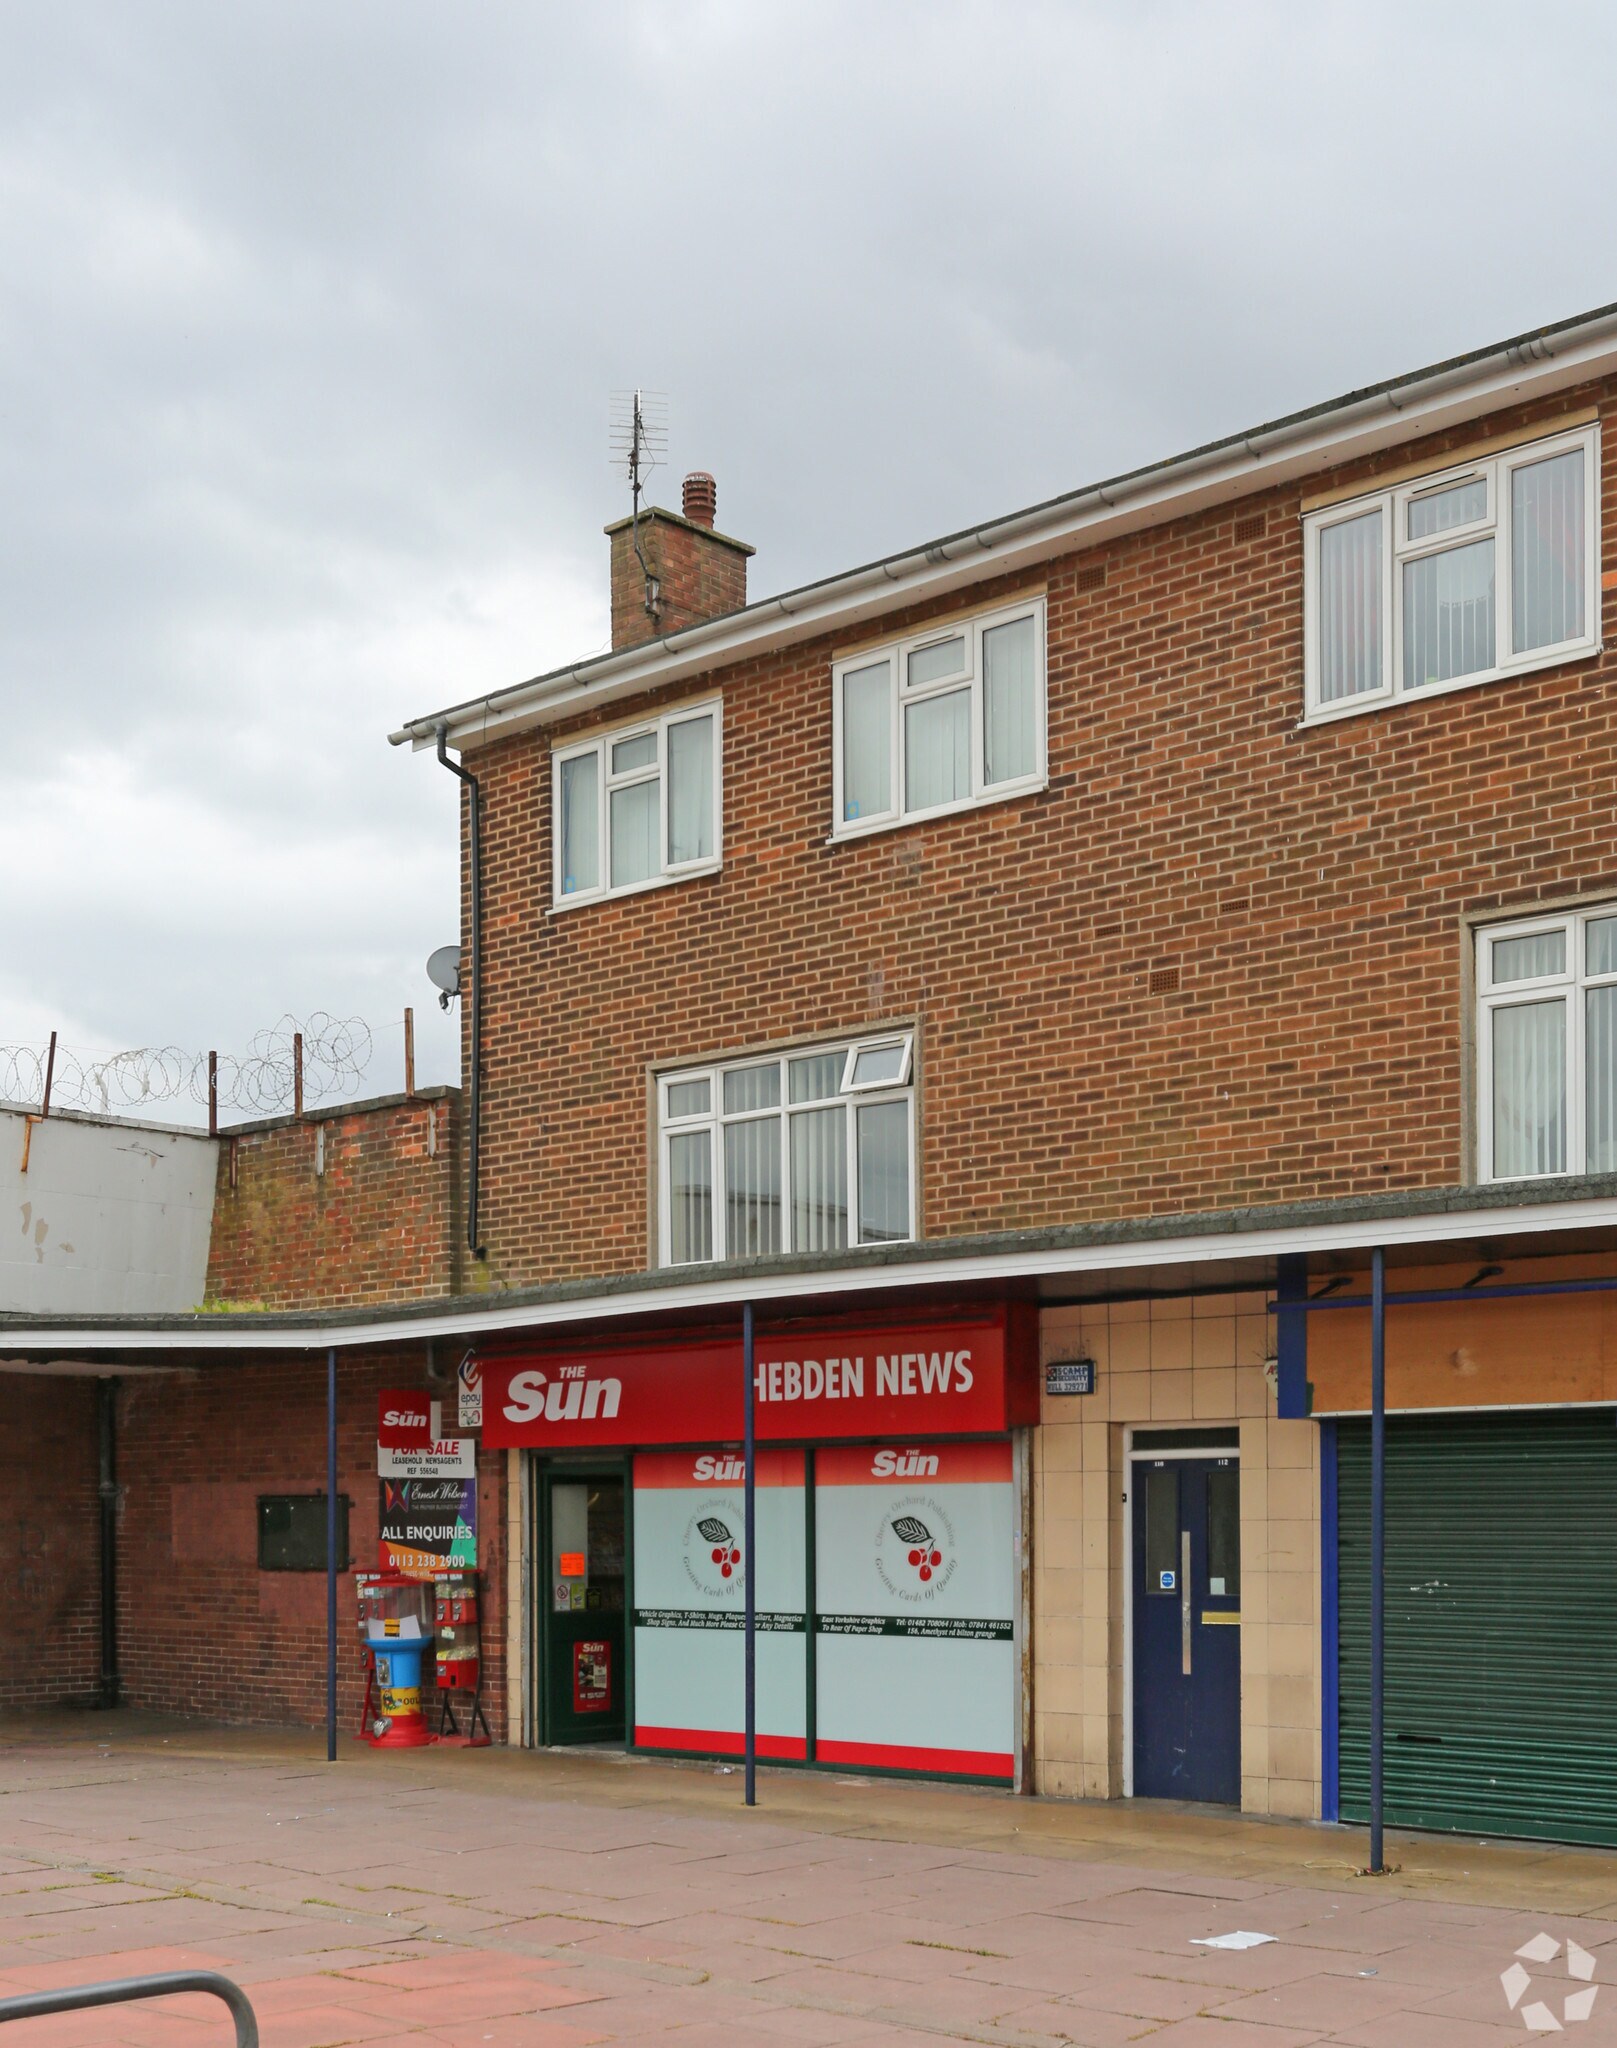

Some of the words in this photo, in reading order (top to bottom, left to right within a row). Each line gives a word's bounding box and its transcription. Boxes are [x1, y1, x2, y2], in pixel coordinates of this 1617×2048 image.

[559, 1365, 587, 1379] THE
[876, 1350, 974, 1397] NEWS
[1058, 1366, 1088, 1376] SCAMP
[1047, 1383, 1062, 1391] HULL
[461, 1393, 481, 1406] epay
[502, 1370, 622, 1423] Sun
[382, 1410, 427, 1427] Sun
[426, 1441, 460, 1455] SALE
[693, 1456, 746, 1481] Sun
[871, 1450, 939, 1477] Sun
[411, 1482, 439, 1500] Ernest
[439, 1482, 468, 1499] Wilson
[891, 1496, 926, 1513] Orchard
[928, 1498, 956, 1548] Publishing
[382, 1526, 404, 1540] ALL
[406, 1526, 473, 1542] ENQUIRIES
[389, 1554, 413, 1567] 0113
[418, 1554, 436, 1567] 238
[440, 1555, 465, 1568] 2900
[898, 1588, 922, 1602] Cards
[924, 1587, 934, 1601] Of
[936, 1558, 958, 1593] Quality
[704, 1585, 724, 1597] Cards
[639, 1610, 658, 1618] Vehicle
[773, 1615, 803, 1623] Magnetics
[835, 1616, 860, 1624] Yorkshire
[861, 1617, 886, 1626] Graphics
[646, 1618, 660, 1627] Shop
[761, 1623, 773, 1631] Any
[844, 1625, 851, 1633] Of
[851, 1625, 868, 1634] Paper
[868, 1626, 883, 1635] Shop
[920, 1628, 948, 1636] Amethyst
[975, 1631, 996, 1639] grange
[582, 1643, 604, 1652] Sun
